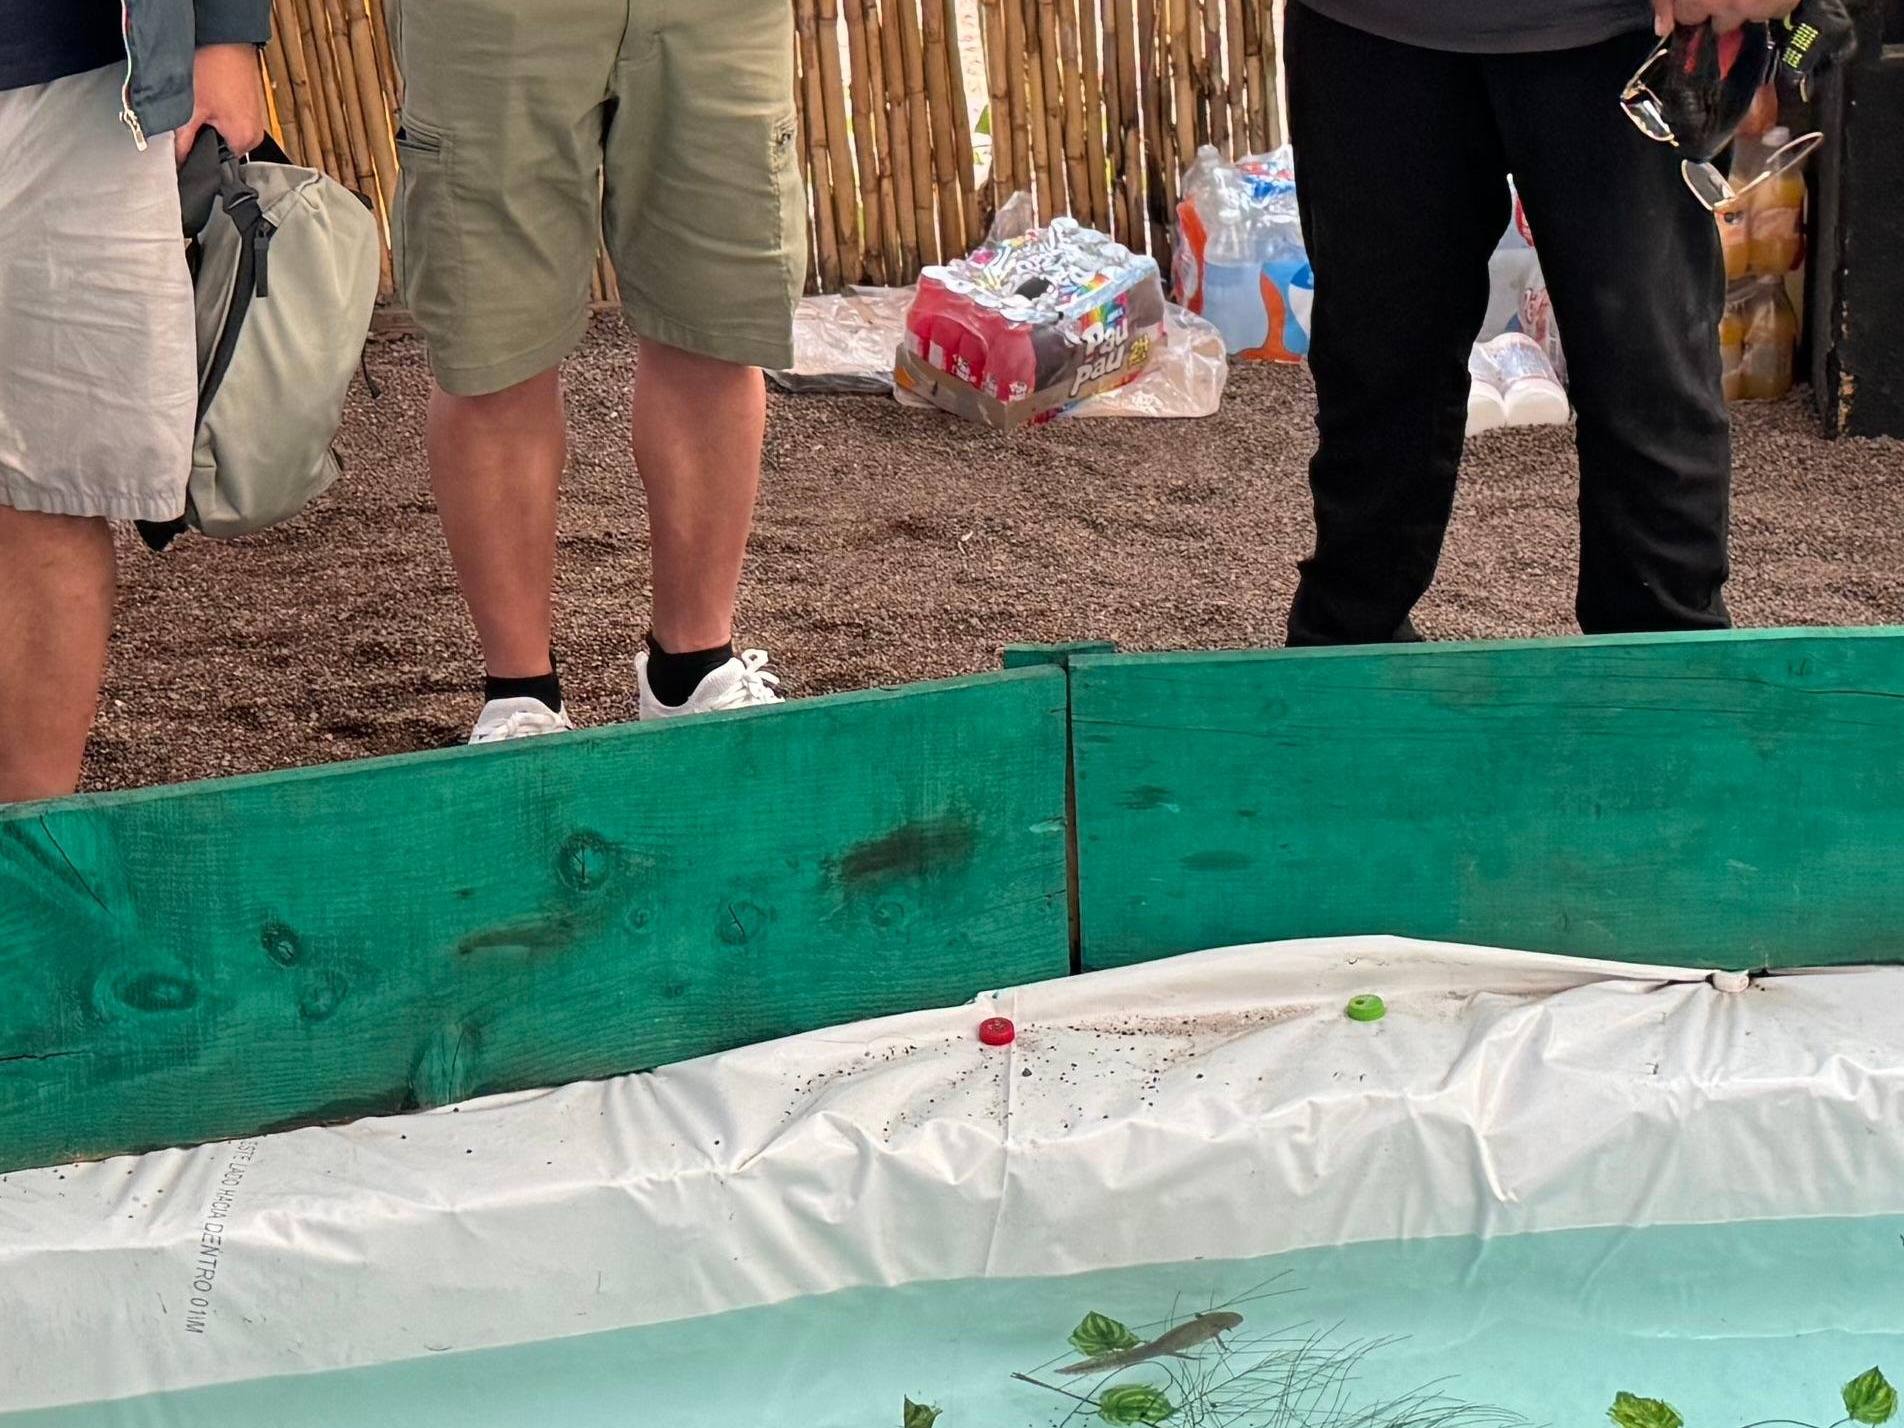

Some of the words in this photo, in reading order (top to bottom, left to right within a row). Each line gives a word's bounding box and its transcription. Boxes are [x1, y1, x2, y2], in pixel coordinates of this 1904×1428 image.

[221, 1162, 248, 1186] LADO
[207, 1188, 237, 1219] HACIA
[193, 1222, 224, 1293] DENTRO
